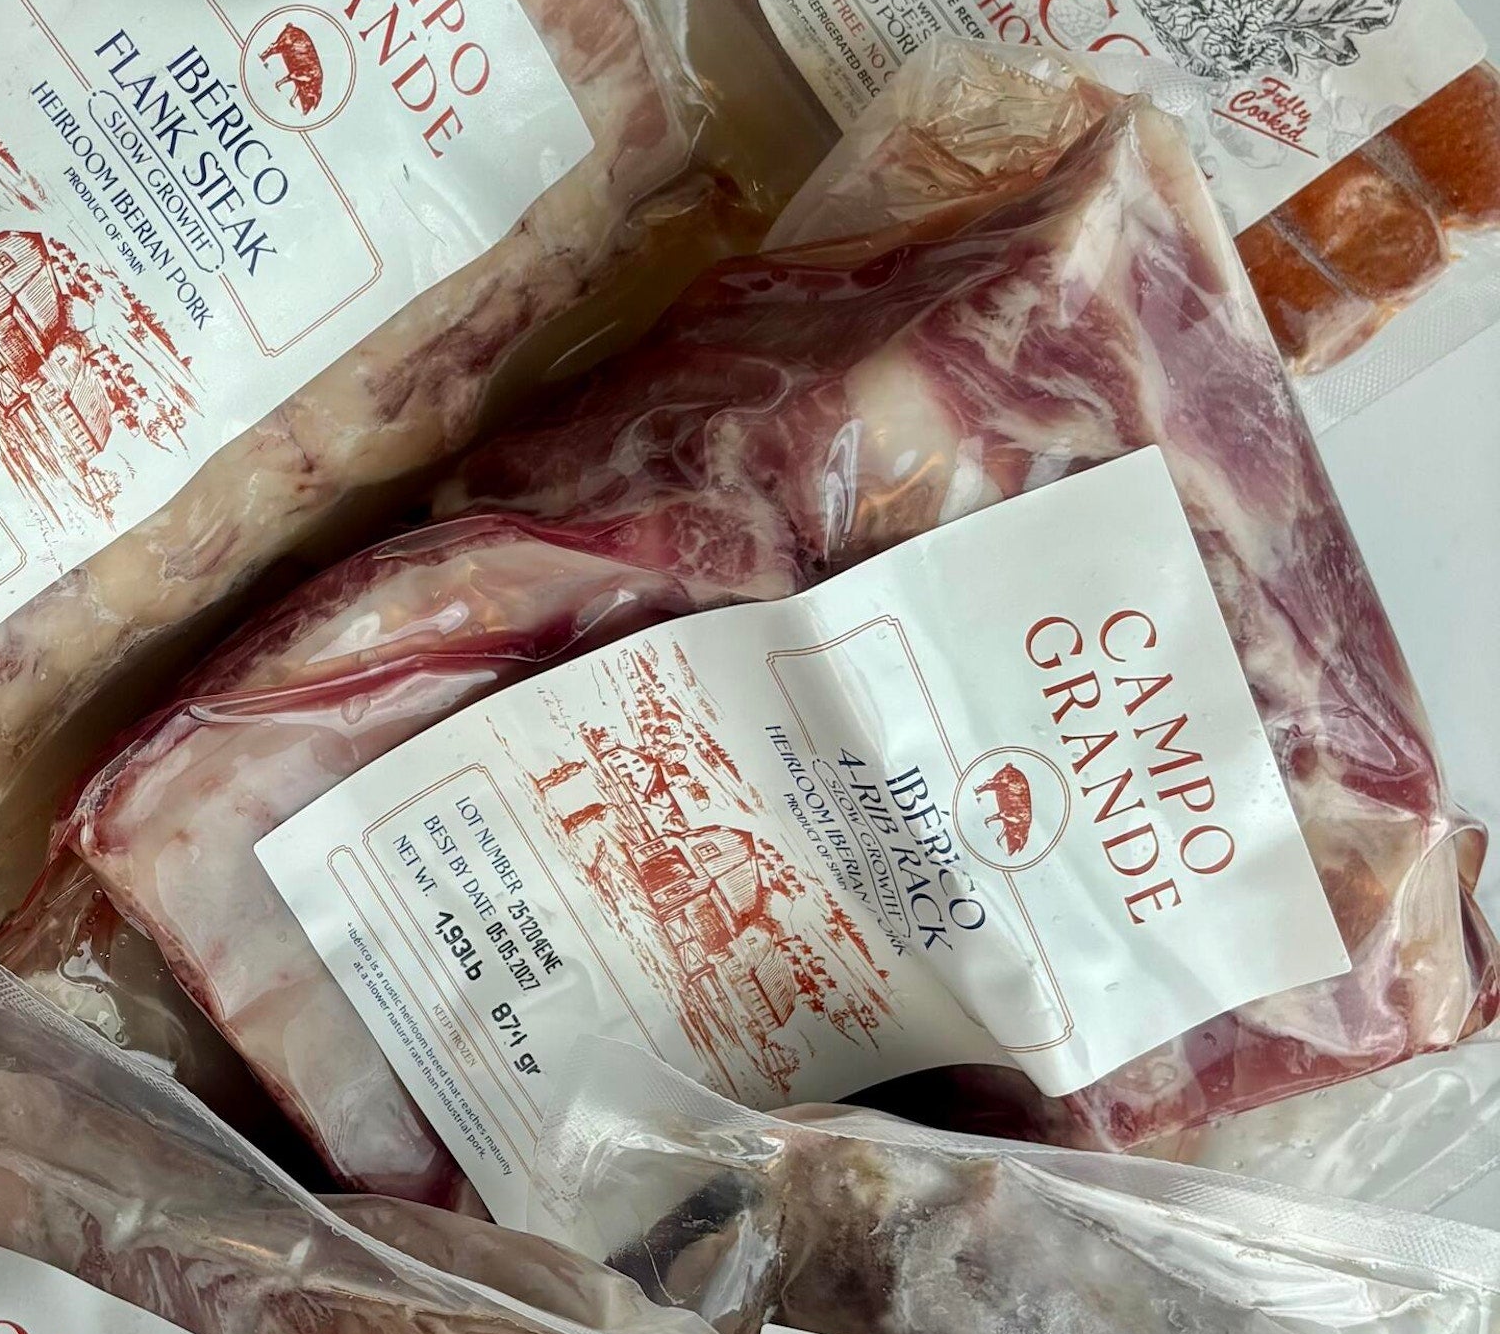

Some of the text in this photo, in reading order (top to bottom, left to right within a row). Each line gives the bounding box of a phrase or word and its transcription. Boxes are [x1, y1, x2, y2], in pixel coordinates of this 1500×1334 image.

[916, 1, 941, 32] WITH
[953, 5, 985, 39] RECIP
[94, 28, 277, 276] FLANK STEAK
[103, 110, 152, 164] SLOW
[165, 44, 288, 205] IBÉRICO
[1228, 90, 1307, 143] Cooked
[30, 80, 213, 331] HEIRLOOM IBERIAN PORK
[62, 166, 146, 276] PRODUCT OF SPAIN
[1025, 616, 1181, 924] GRANDE
[1099, 609, 1235, 875] CAMPO
[422, 814, 540, 991] BEST BY DATE 05.05.2027
[454, 796, 563, 975] LOT NUMBER 251204ENE
[837, 748, 953, 950] 4-RIB RACK
[884, 765, 986, 930] IBÉRICO
[512, 1052, 541, 1075] gr
